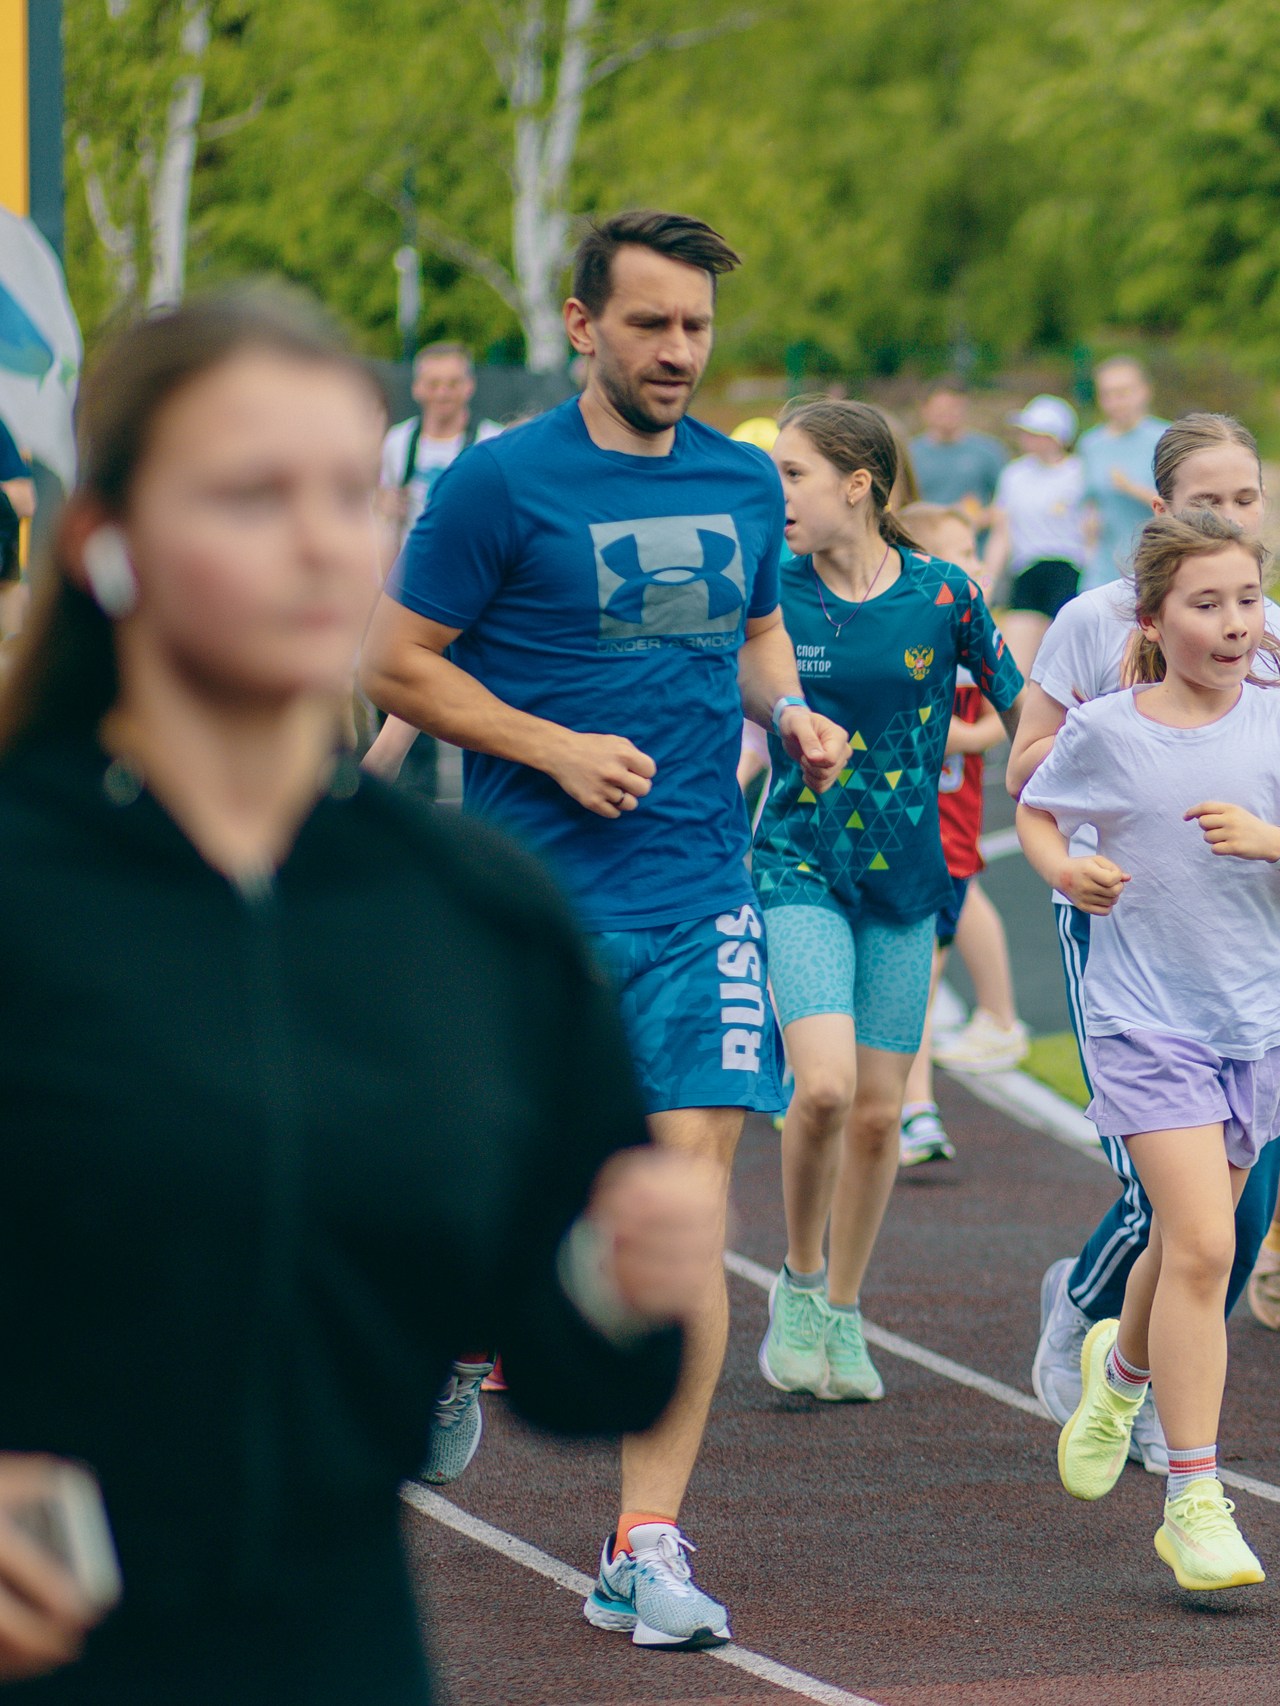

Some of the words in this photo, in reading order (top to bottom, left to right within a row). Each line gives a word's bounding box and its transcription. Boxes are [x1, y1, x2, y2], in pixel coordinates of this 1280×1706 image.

[597, 638, 661, 653] UNDER
[796, 645, 826, 658] СПОРТ
[796, 660, 832, 672] ВЕКТОР
